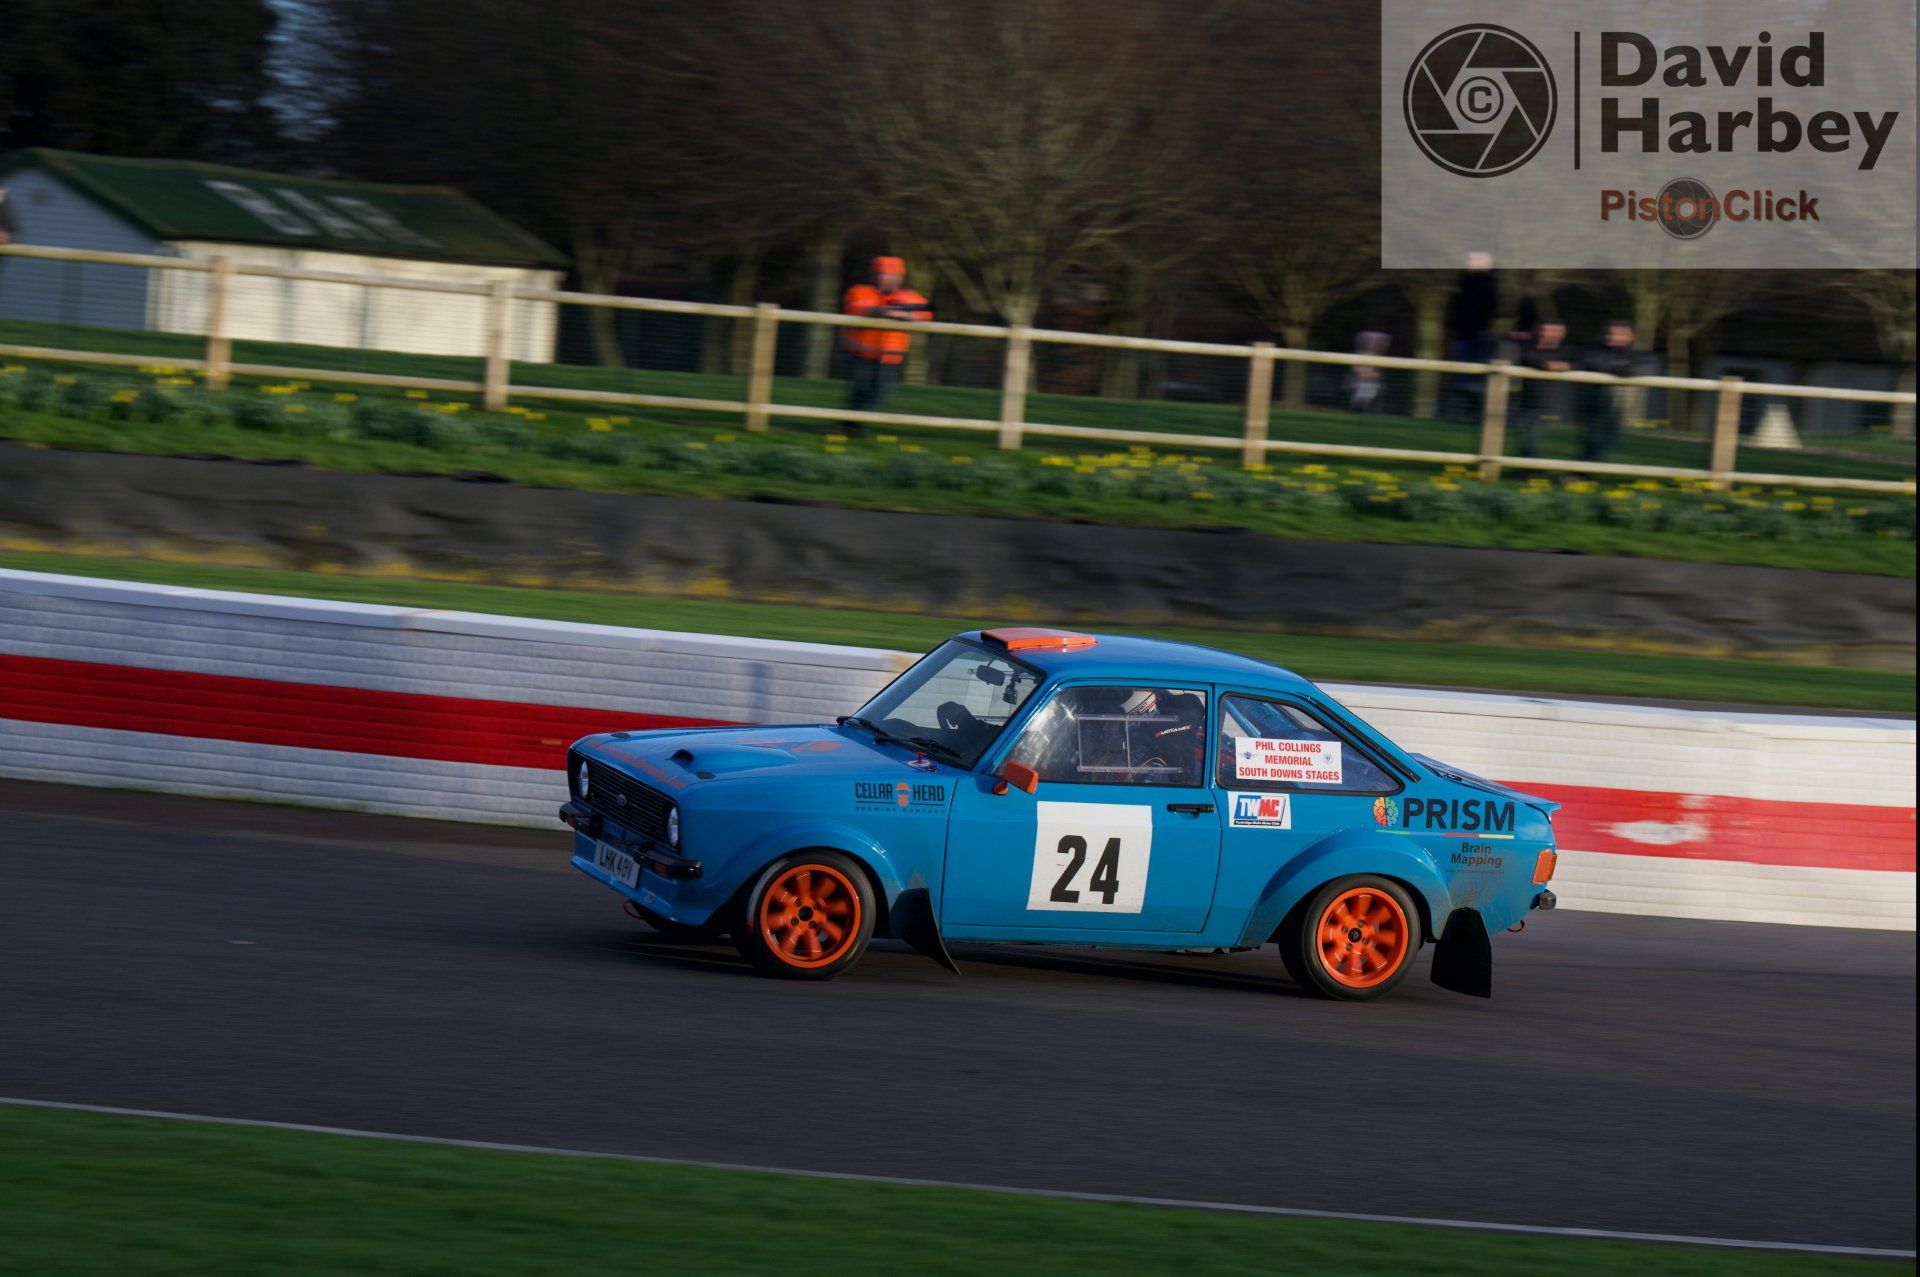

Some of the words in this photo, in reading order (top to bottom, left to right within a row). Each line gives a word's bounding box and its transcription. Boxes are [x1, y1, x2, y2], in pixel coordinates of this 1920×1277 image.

[1255, 741, 1276, 751] PHIL
[1278, 742, 1322, 753] COLLINGS
[1264, 755, 1313, 766] MEMORIAL
[1239, 767, 1268, 777] SOUTH
[1270, 768, 1303, 779] DOWNS
[1305, 770, 1340, 781] STAGES
[855, 783, 893, 799] CELLAR
[913, 784, 945, 801] HEAD
[1239, 798, 1280, 817] TWMC
[1402, 797, 1515, 832] PRISM
[1461, 842, 1492, 854] Brain
[1450, 853, 1503, 868] Mapping
[1049, 834, 1121, 904] 24
